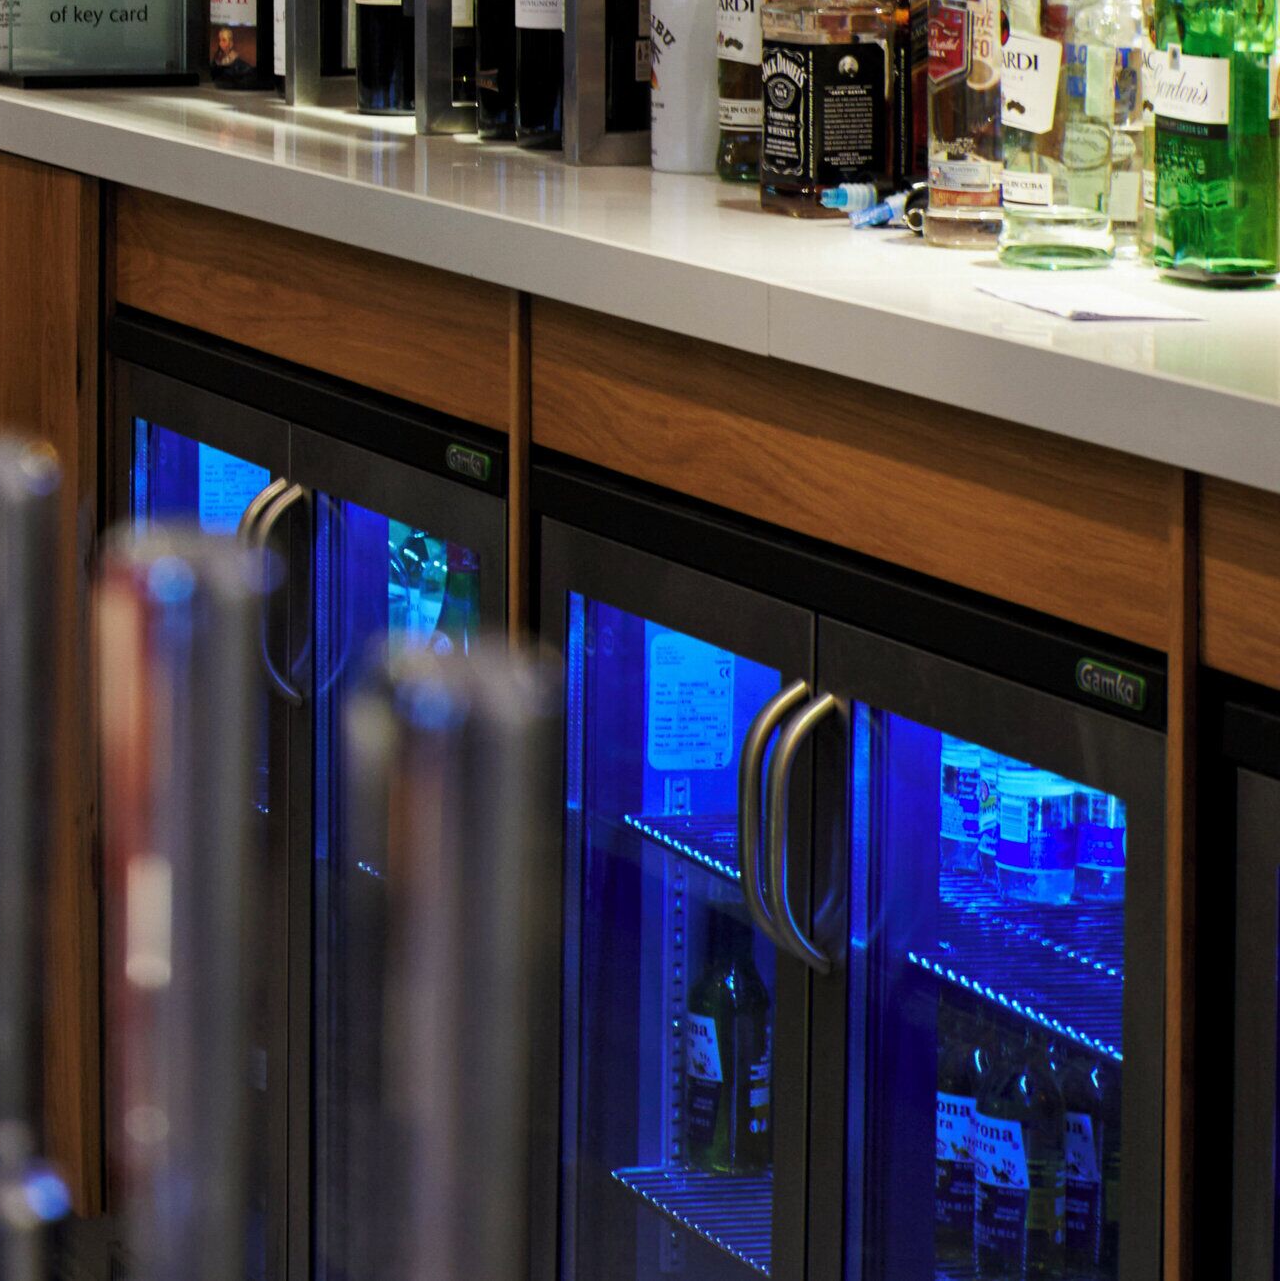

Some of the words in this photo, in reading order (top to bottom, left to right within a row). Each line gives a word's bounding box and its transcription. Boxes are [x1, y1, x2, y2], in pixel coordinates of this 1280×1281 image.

[50, 5, 69, 23] of
[74, 5, 103, 27] key
[109, 5, 148, 23] card
[651, 15, 676, 47] IBU
[1002, 50, 1038, 71] ARDI
[1081, 663, 1134, 705] Gamko
[976, 1121, 1013, 1143] rona
